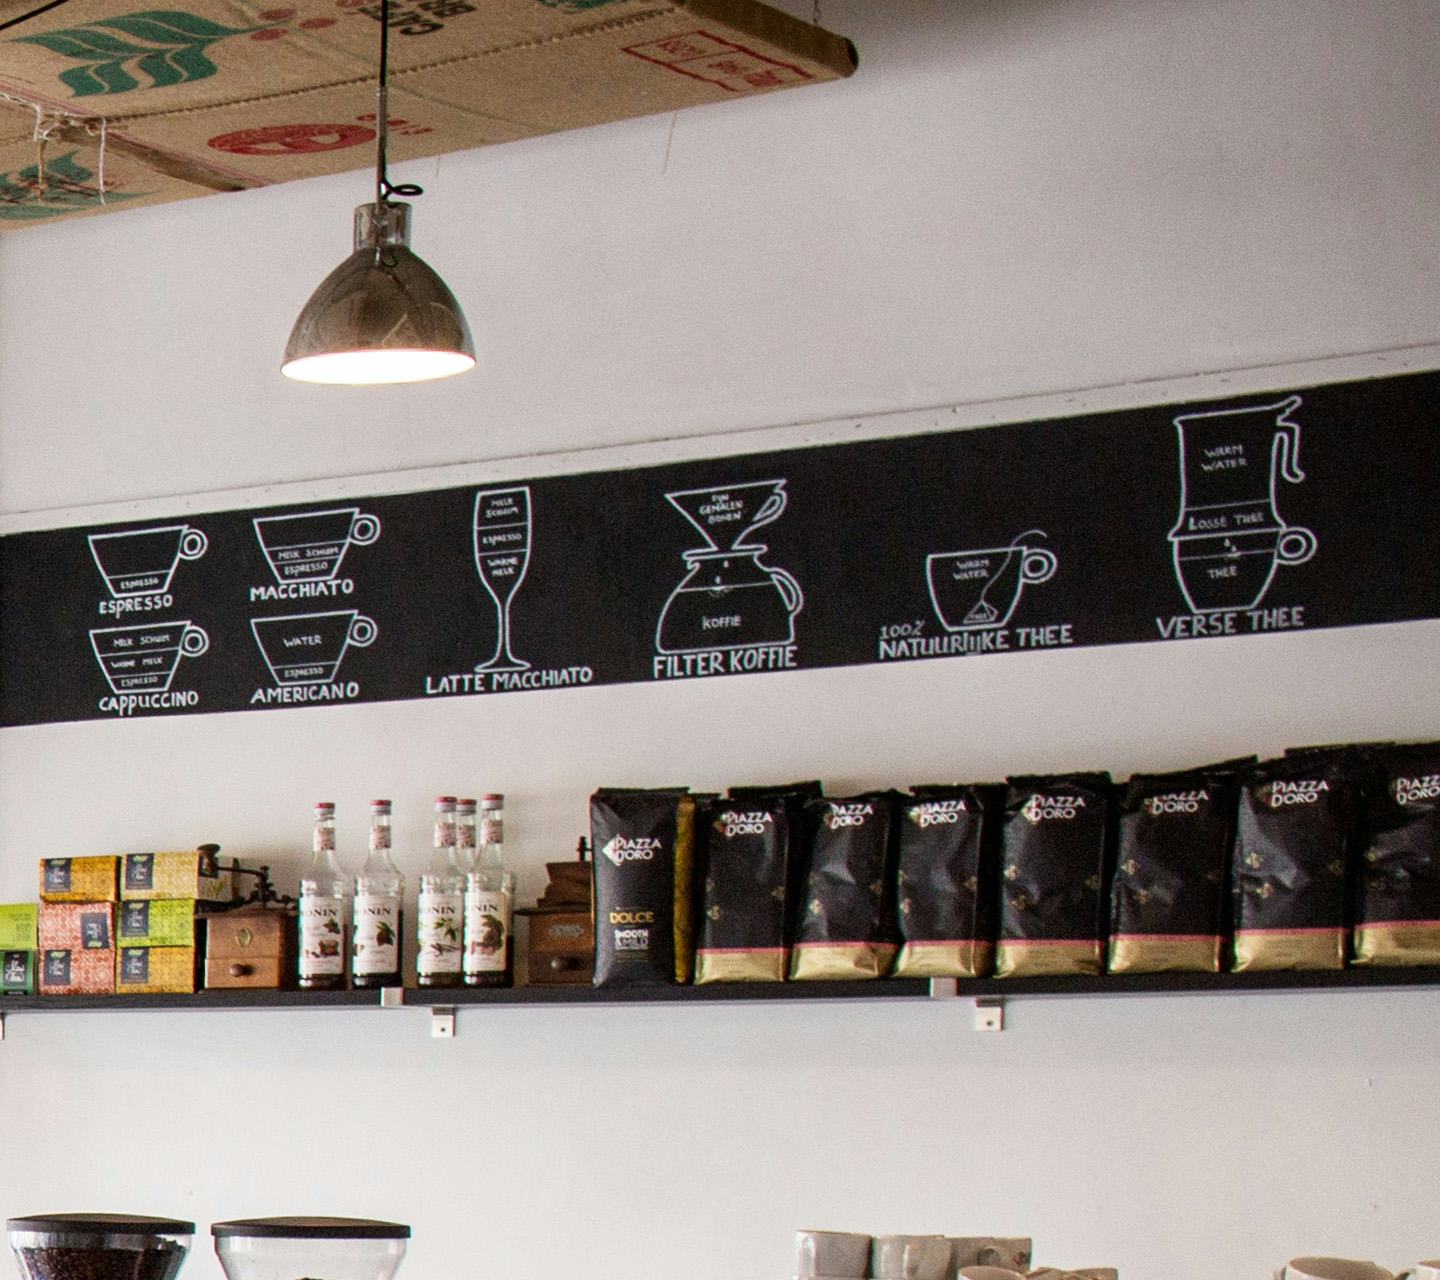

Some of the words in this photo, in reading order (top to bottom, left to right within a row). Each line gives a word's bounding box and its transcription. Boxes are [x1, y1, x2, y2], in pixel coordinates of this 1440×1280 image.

[250, 579, 354, 601] MACCHIATO
[99, 595, 173, 619] ESPRESSO
[1157, 612, 1237, 638] VERSE
[1247, 607, 1304, 629] THEE
[283, 635, 322, 648] WATER
[1016, 625, 1073, 646] THEE
[654, 654, 723, 678] FILTER
[731, 646, 798, 671] KOFFIE
[426, 675, 484, 694] LATTE
[492, 667, 592, 691] MACCHIATO
[99, 691, 198, 716] CAPPUCCINO
[251, 682, 359, 704] AMERICANO
[1273, 781, 1329, 795] PIAZZA
[609, 912, 654, 924] DOLCE
